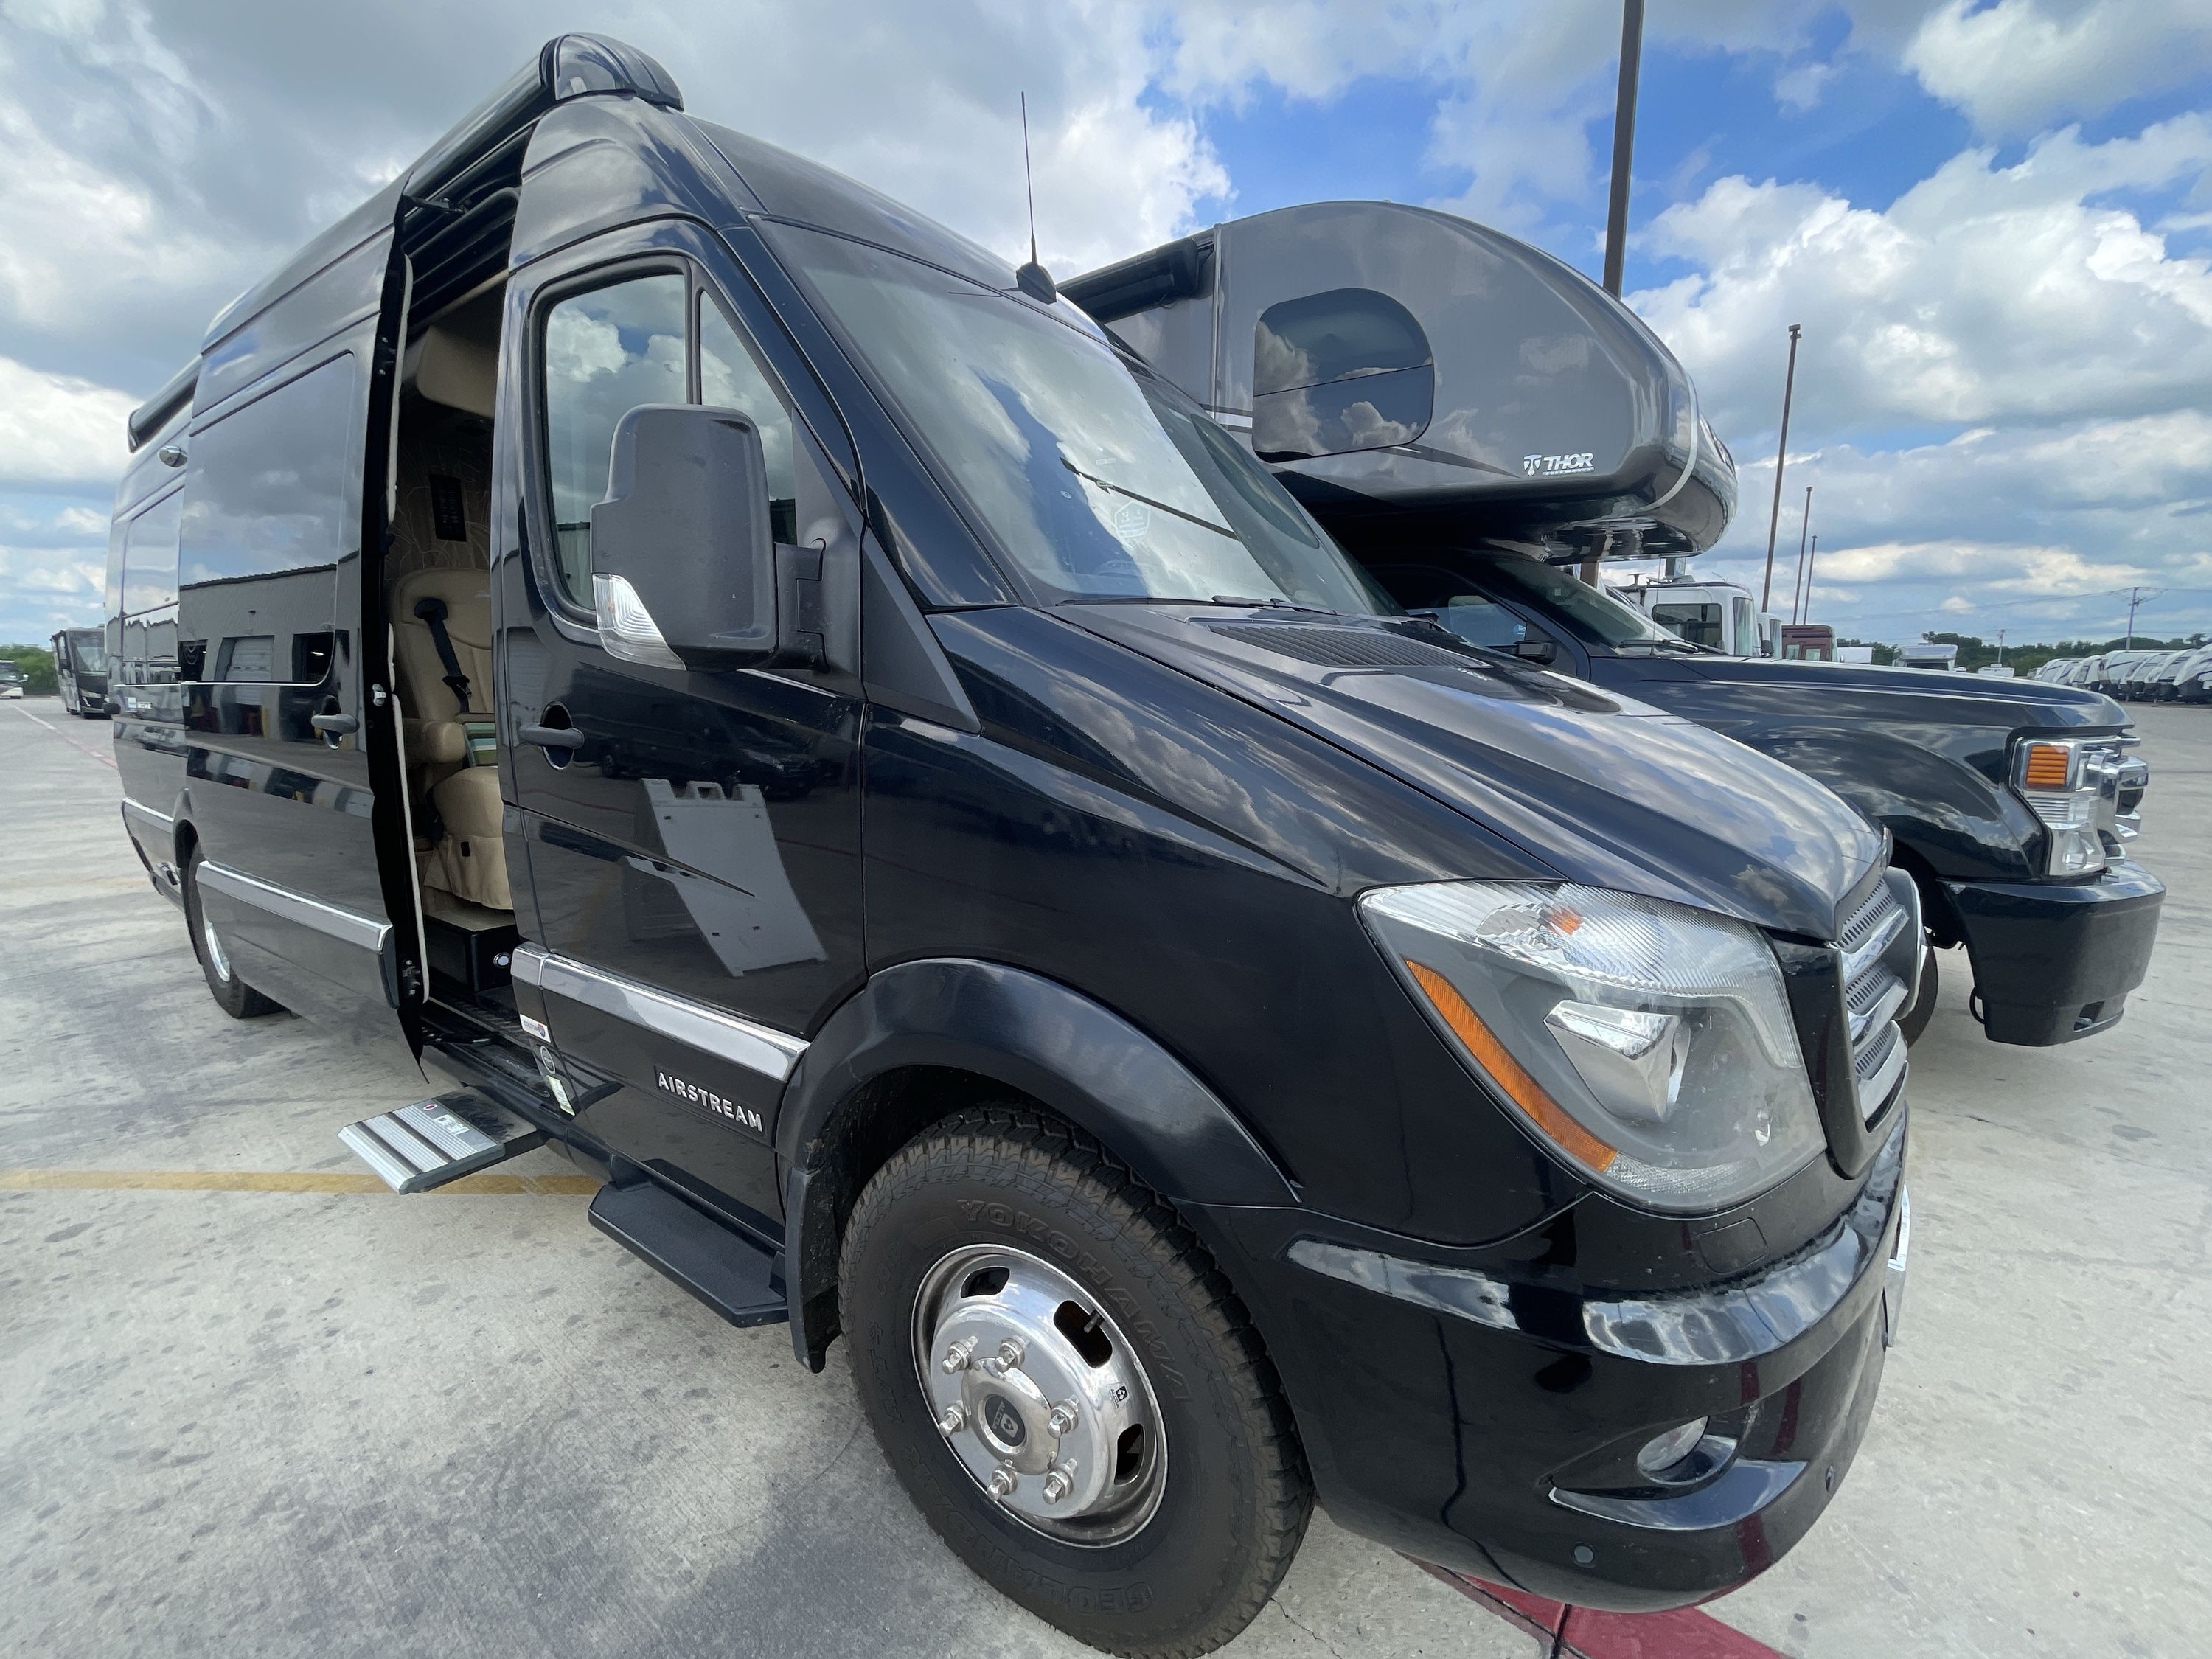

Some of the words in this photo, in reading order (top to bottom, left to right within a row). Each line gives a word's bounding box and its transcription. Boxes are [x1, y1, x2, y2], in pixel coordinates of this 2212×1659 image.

[1543, 452, 1593, 471] THOR
[658, 1072, 763, 1132] AIRSTREAM
[956, 1199, 1192, 1399] YOKOHAMA
